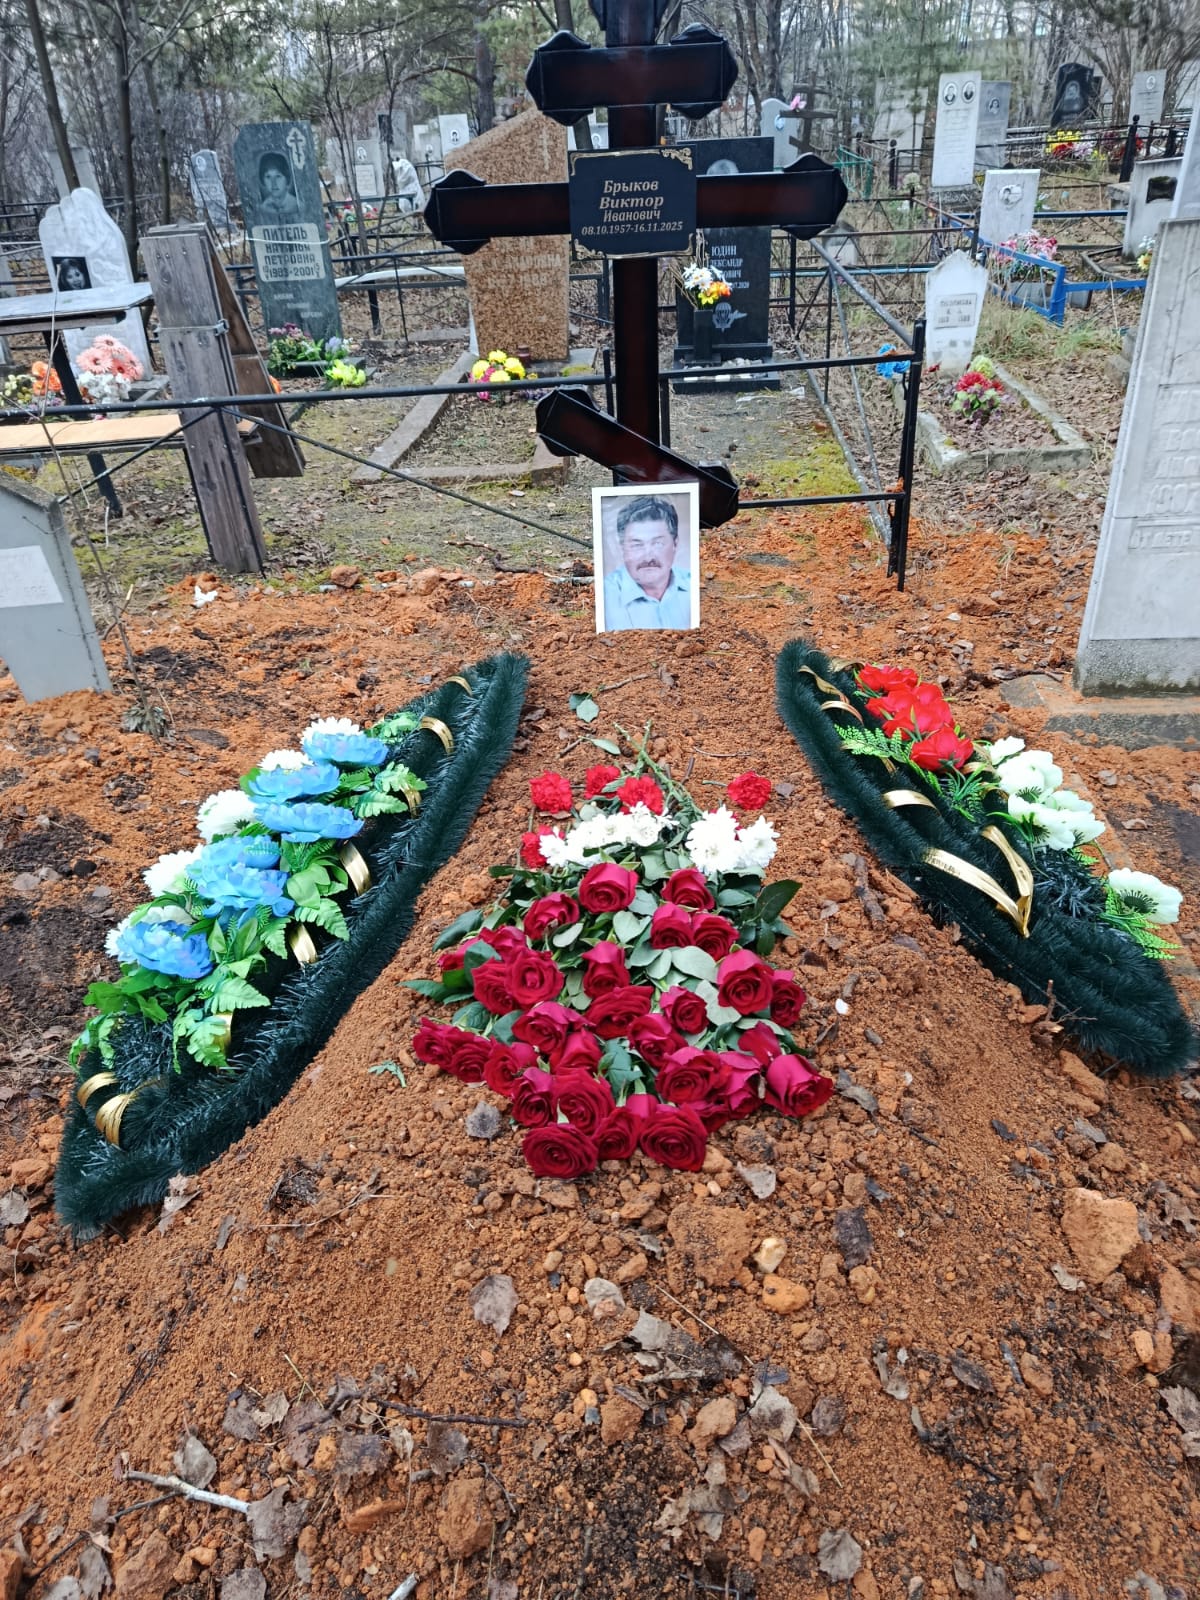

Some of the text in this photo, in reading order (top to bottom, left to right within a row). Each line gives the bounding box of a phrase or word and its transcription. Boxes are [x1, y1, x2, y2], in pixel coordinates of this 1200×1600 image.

[603, 180, 659, 195] Брыков
[600, 196, 664, 209] Виктор
[603, 210, 661, 222] Иванович
[581, 221, 683, 235] 08.10.1957-16.11.2025
[264, 253, 316, 265] ПЕТРОВНА
